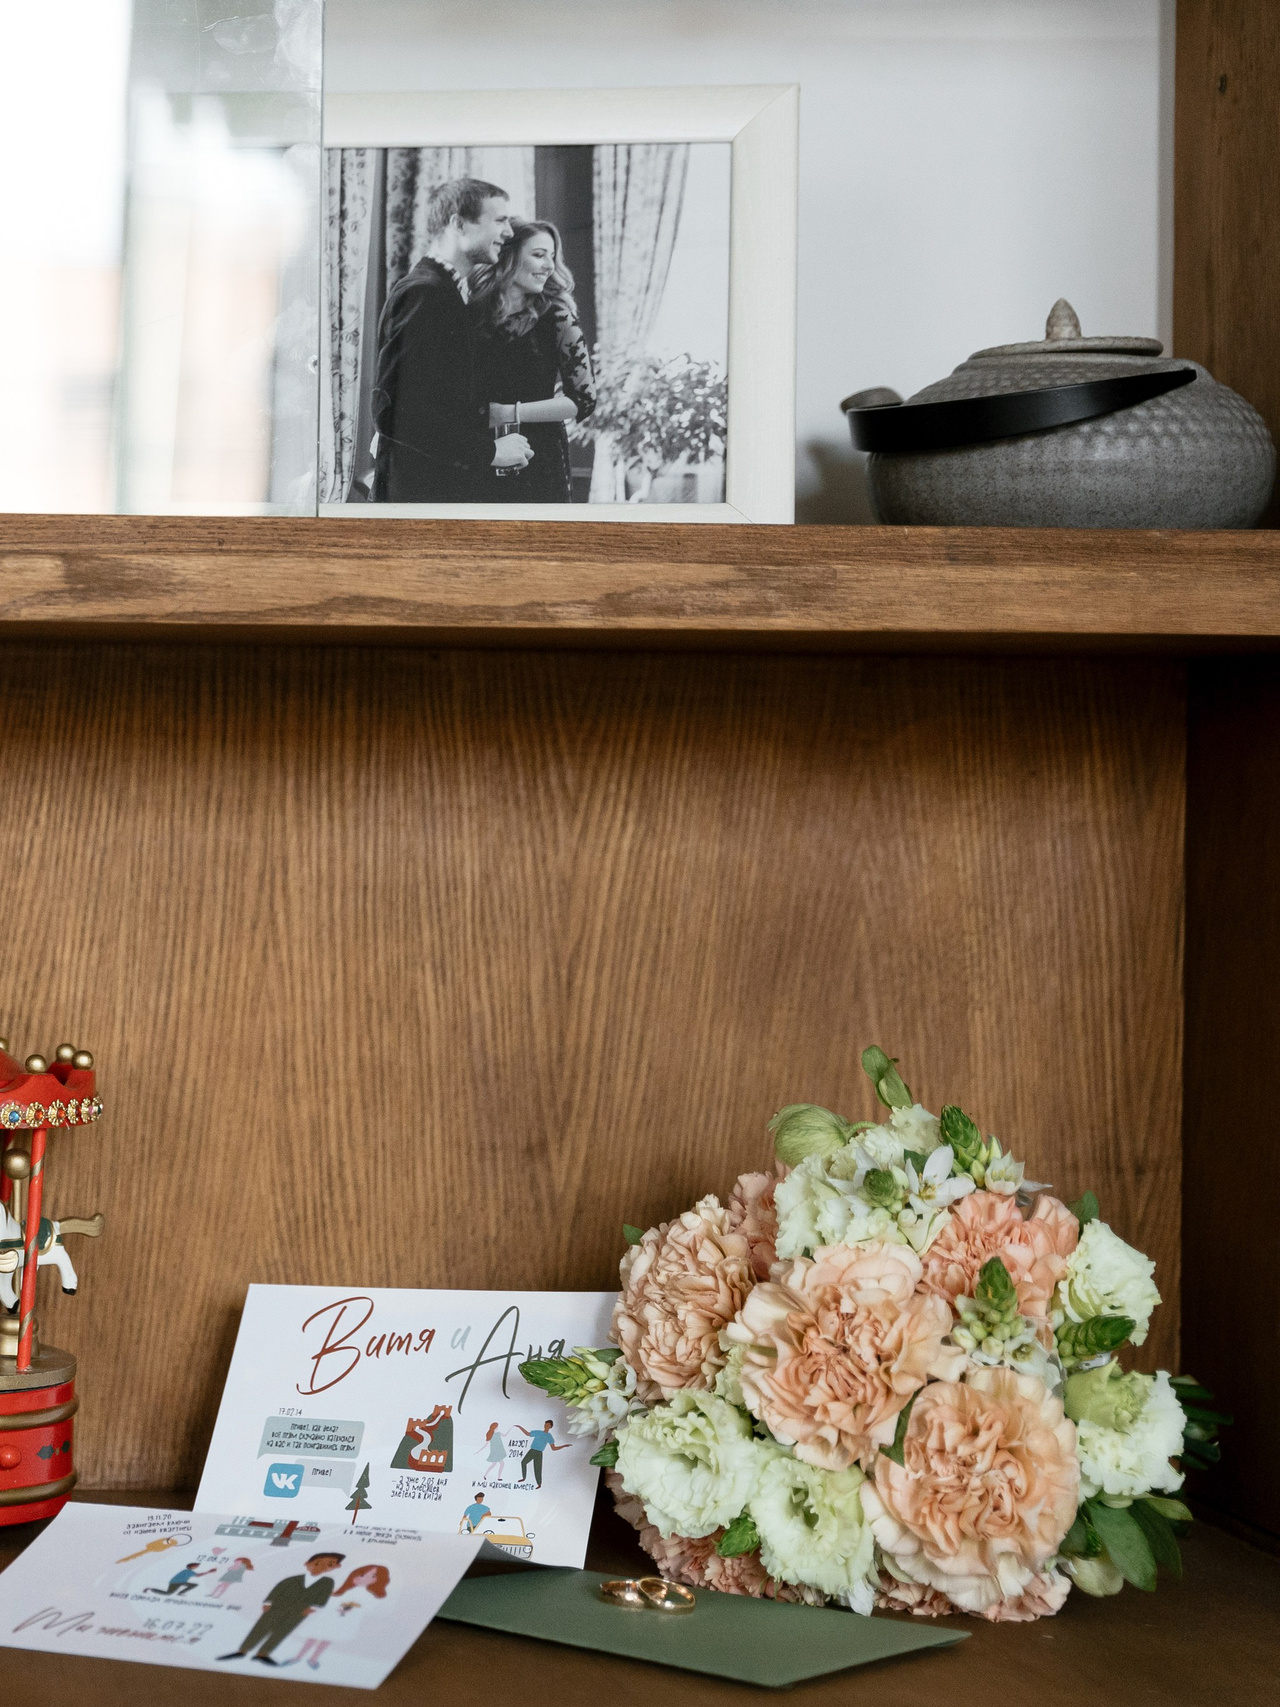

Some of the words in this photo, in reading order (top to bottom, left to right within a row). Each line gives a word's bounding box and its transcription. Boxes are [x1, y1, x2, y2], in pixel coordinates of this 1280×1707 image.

[296, 1296, 436, 1396] Витя
[445, 1305, 566, 1415] Аня
[508, 1449, 524, 1458] 2014
